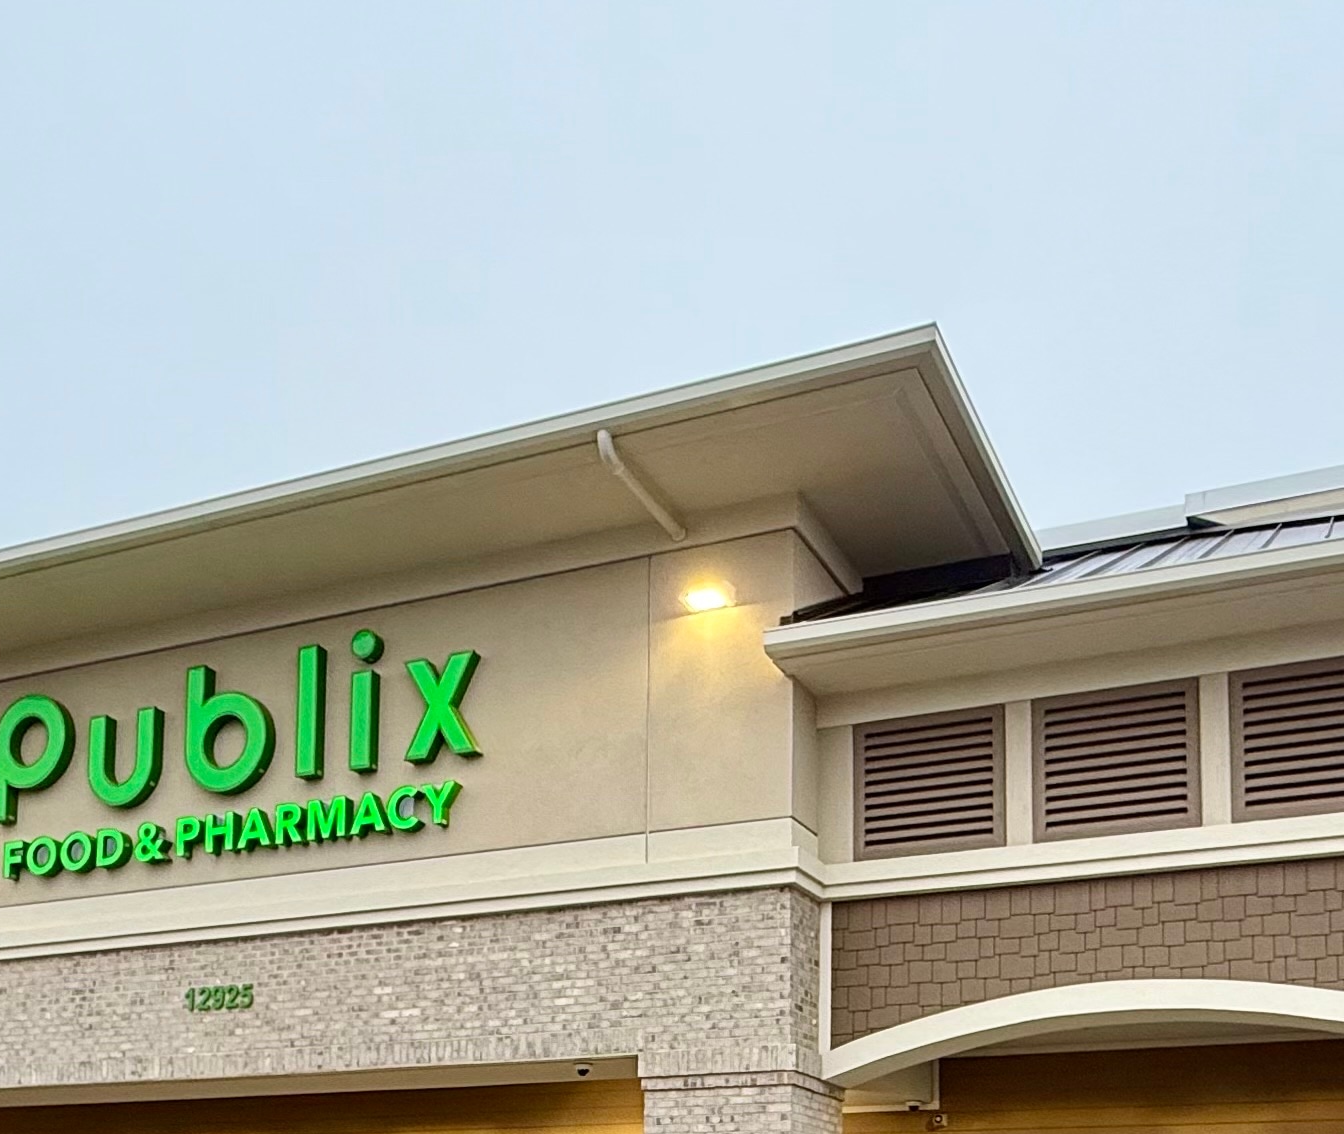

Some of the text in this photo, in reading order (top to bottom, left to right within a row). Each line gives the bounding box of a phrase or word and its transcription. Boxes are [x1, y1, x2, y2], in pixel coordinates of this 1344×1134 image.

[3, 780, 463, 880] FOOD & PHARMACY
[184, 983, 254, 1012] 12925
